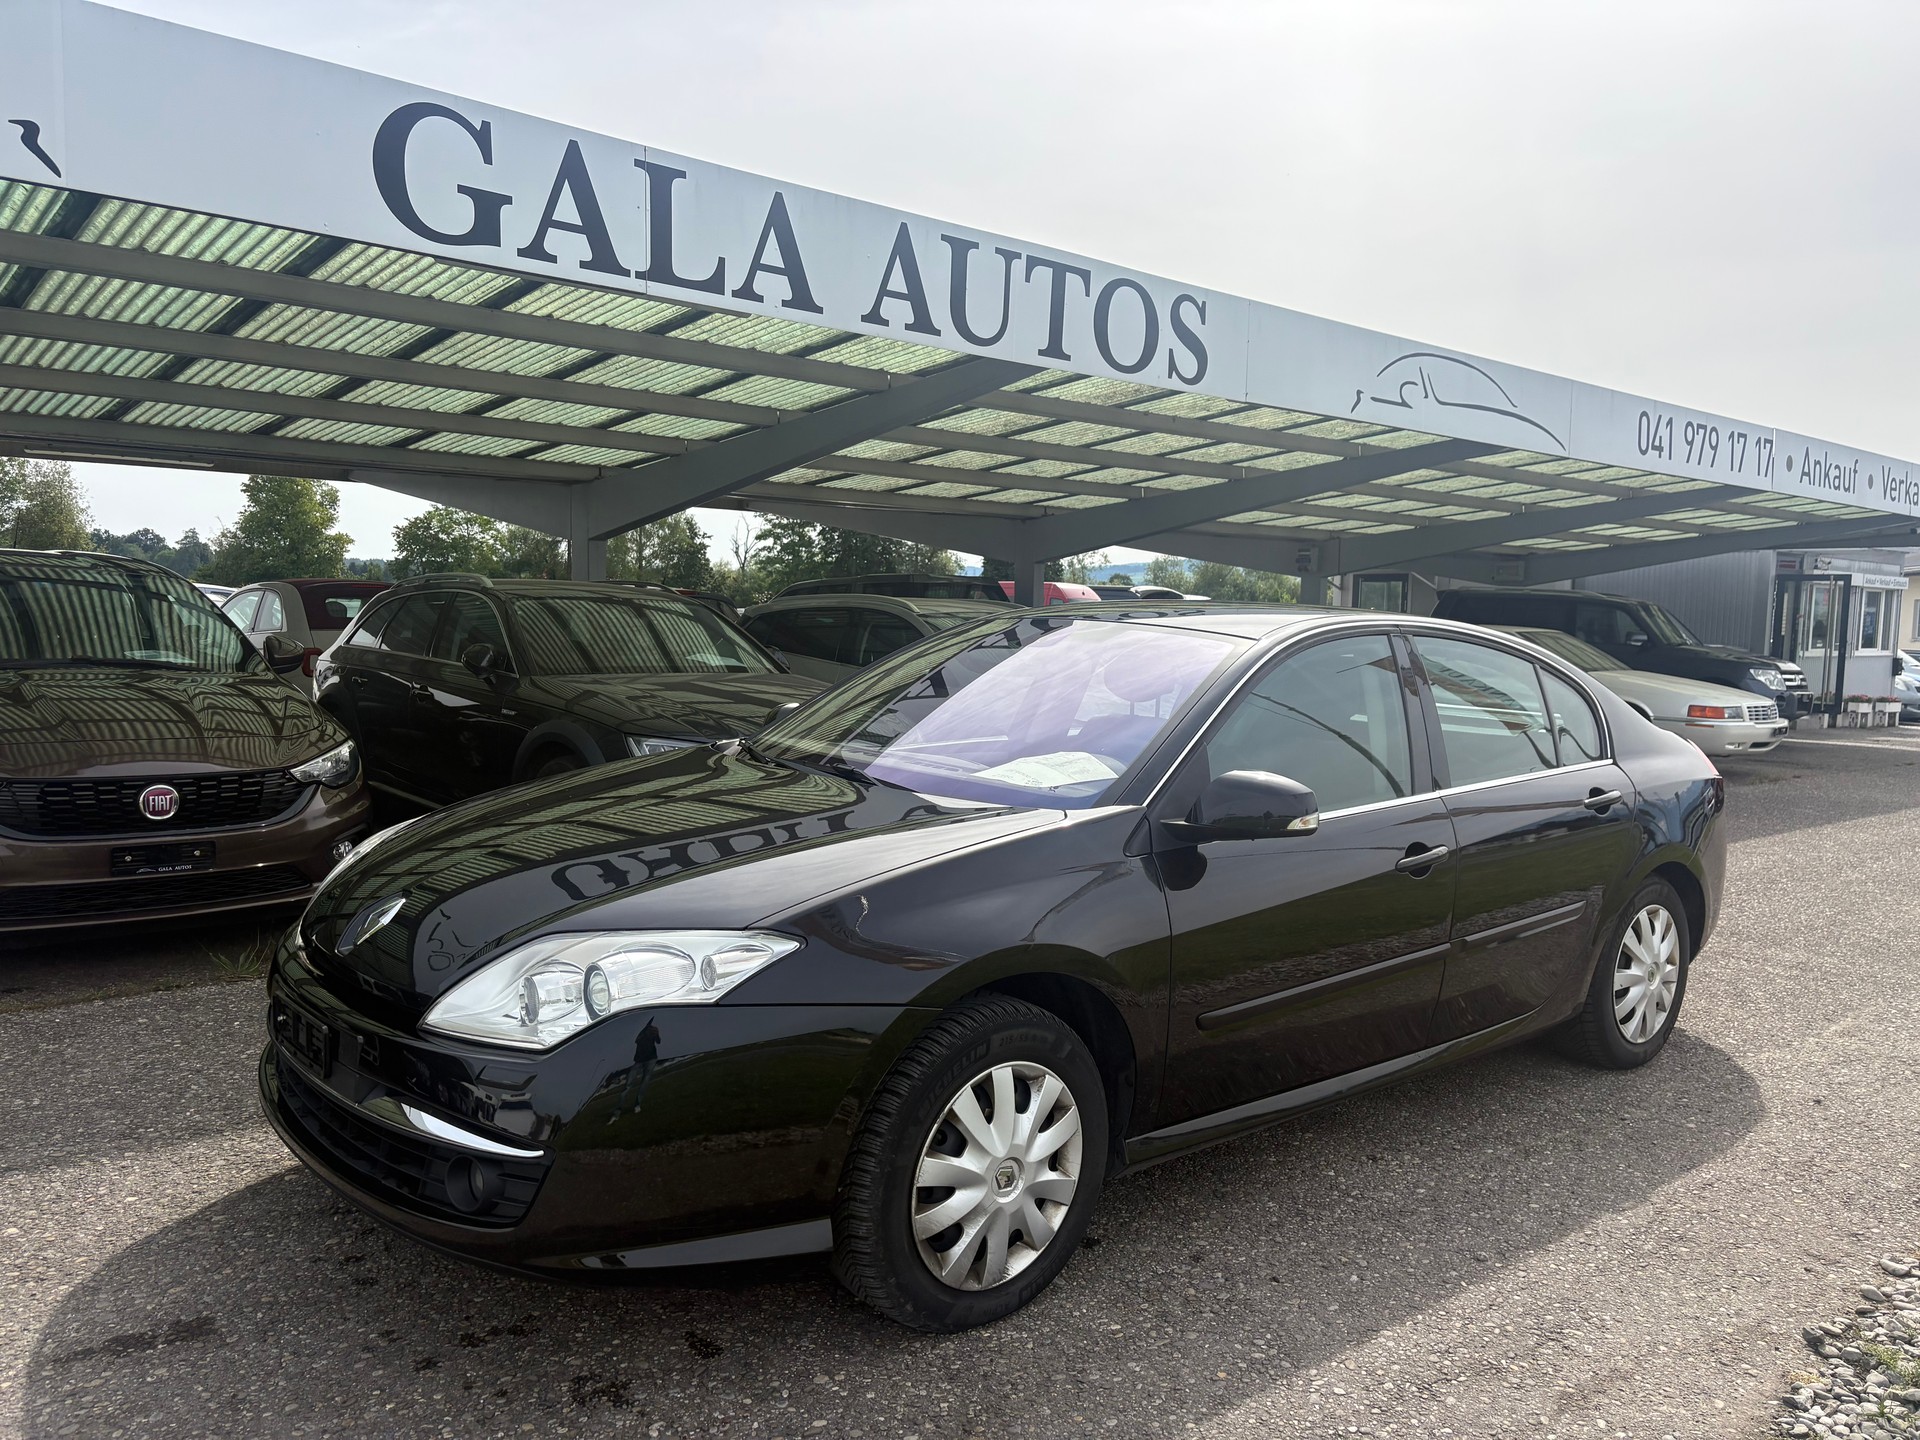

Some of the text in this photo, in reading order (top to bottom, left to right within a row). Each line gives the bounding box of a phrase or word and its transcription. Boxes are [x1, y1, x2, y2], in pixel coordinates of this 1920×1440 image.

[373, 102, 1209, 386] GALA AUTOS
[1637, 410, 1920, 507] 041 979 17 17 Ankauf Verka
[149, 794, 173, 811] FIAT
